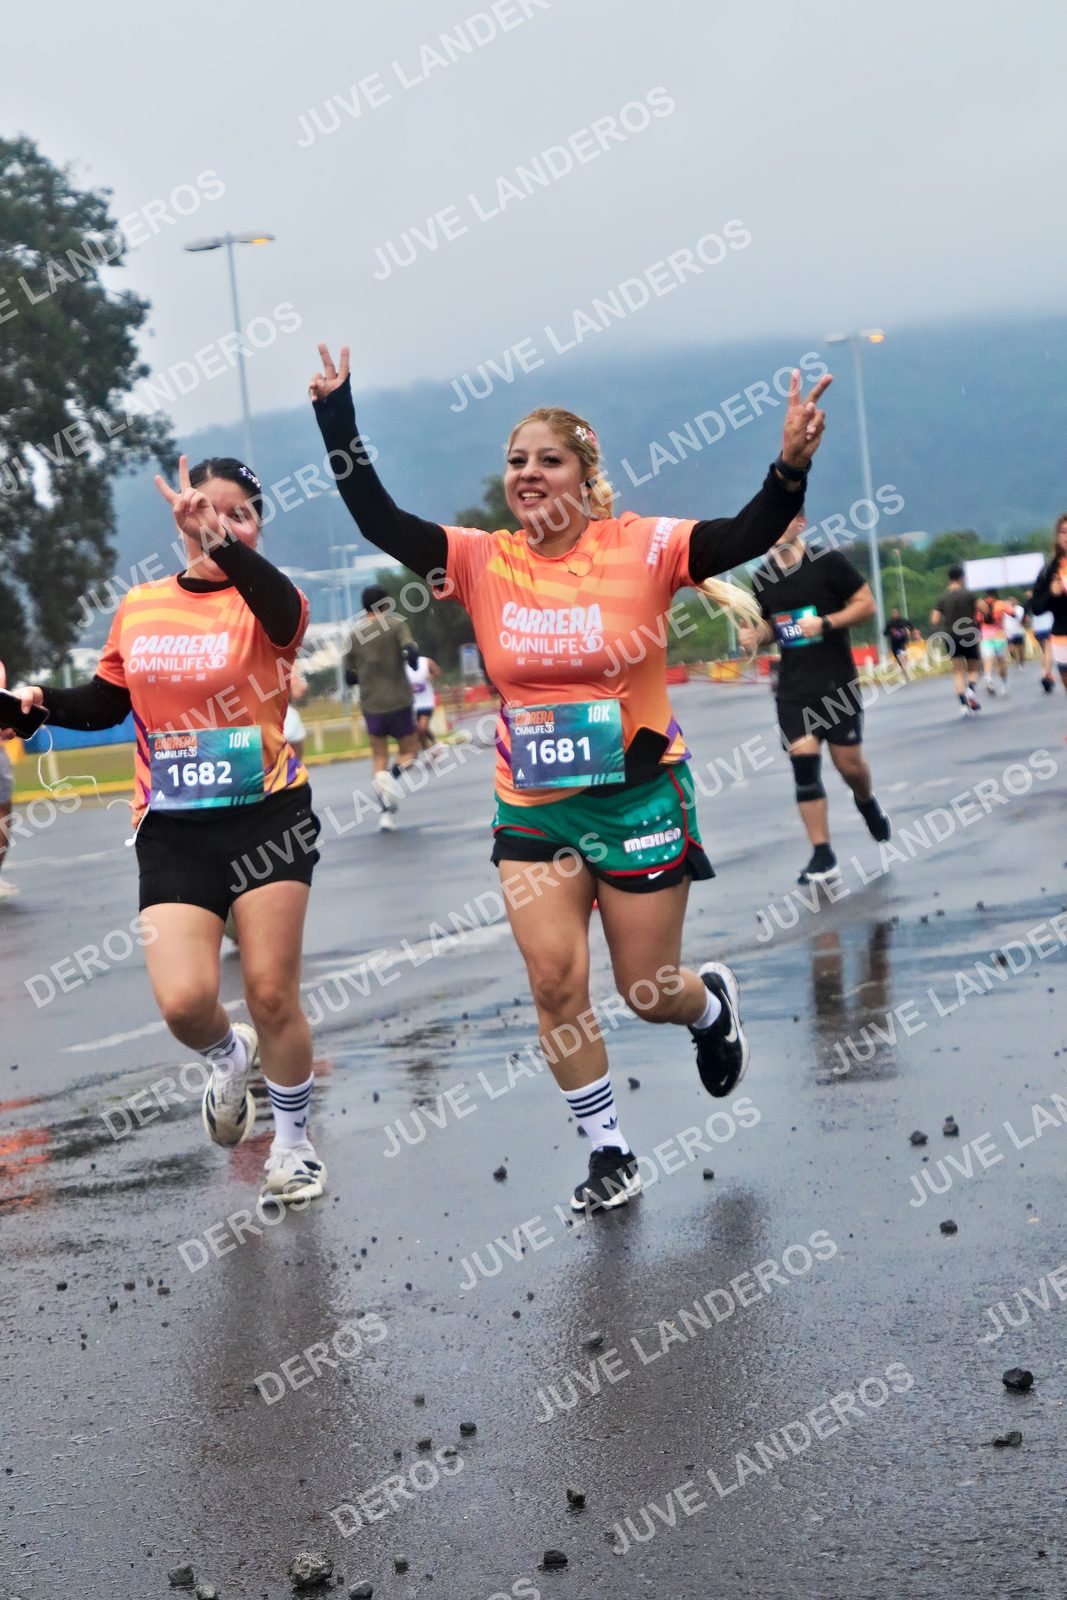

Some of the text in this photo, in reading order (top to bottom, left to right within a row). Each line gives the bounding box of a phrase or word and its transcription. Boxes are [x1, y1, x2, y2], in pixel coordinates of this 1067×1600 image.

[502, 601, 602, 634] CARRERA
[131, 631, 229, 656] CARRERA
[499, 630, 579, 655] OMNILIFE
[128, 656, 205, 673] OMNILIFE
[588, 705, 610, 723] 10K
[228, 731, 250, 749] 10K
[515, 725, 545, 736] OMNILIFE
[154, 750, 188, 760] OMNILIFE
[526, 736, 591, 765] 1681
[167, 760, 233, 787] 1682
